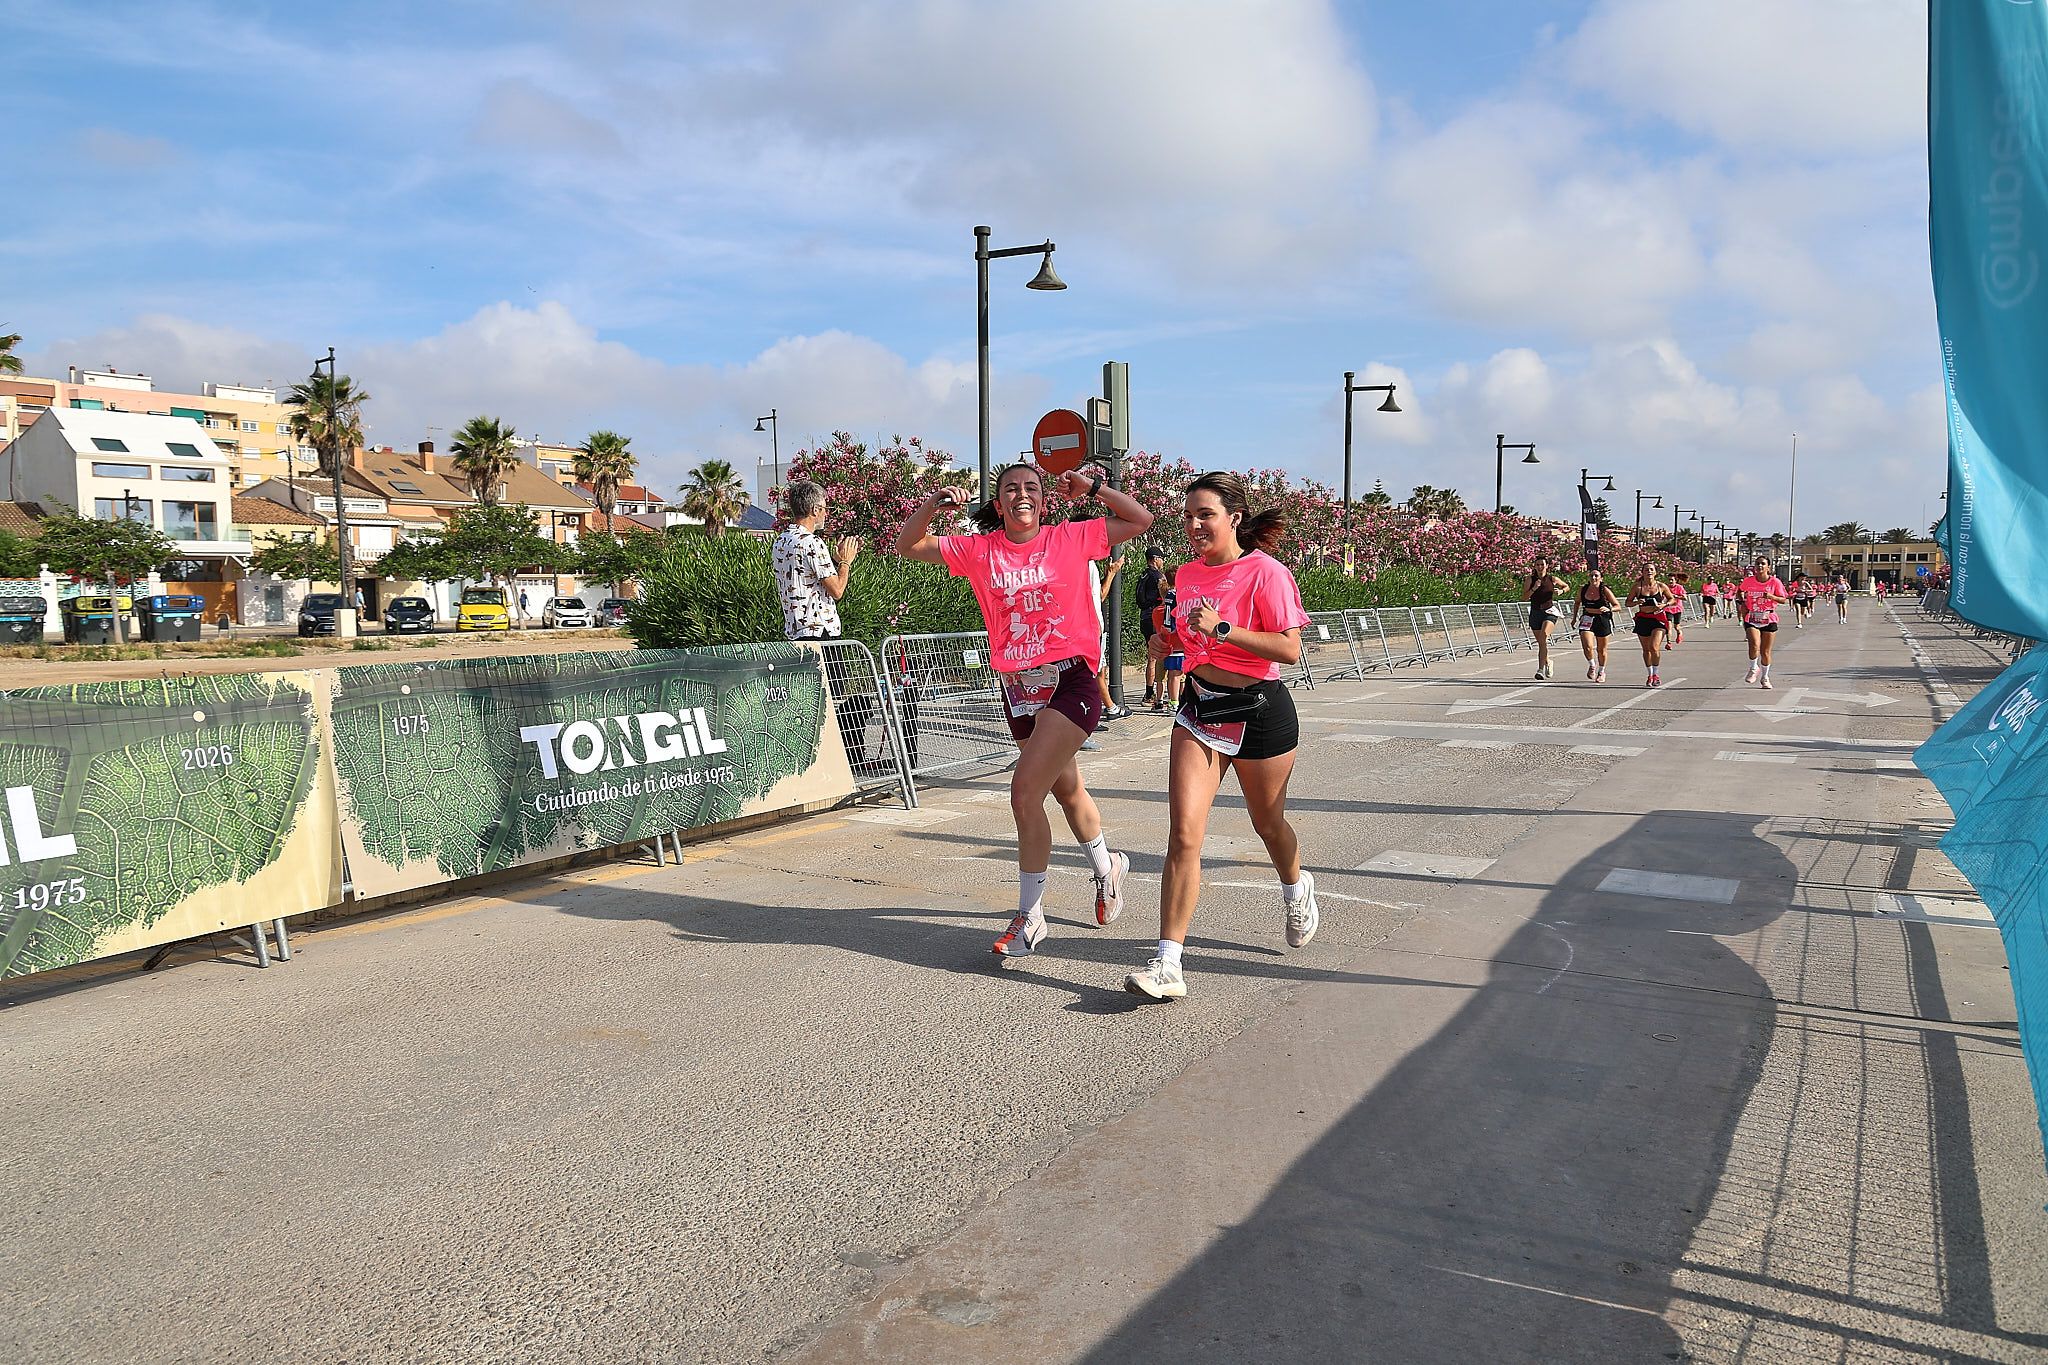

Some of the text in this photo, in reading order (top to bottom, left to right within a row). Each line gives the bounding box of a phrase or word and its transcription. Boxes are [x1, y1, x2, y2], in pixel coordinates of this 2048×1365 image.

[1022, 589, 1045, 613] DE
[1026, 623, 1040, 645] LA
[1004, 640, 1047, 662] MUJER
[764, 687, 788, 702] 2026
[391, 714, 430, 736] 1975
[181, 744, 233, 770] 2026
[535, 766, 735, 813] Cuidando de ti desde 1975
[13, 876, 86, 911] 1975
